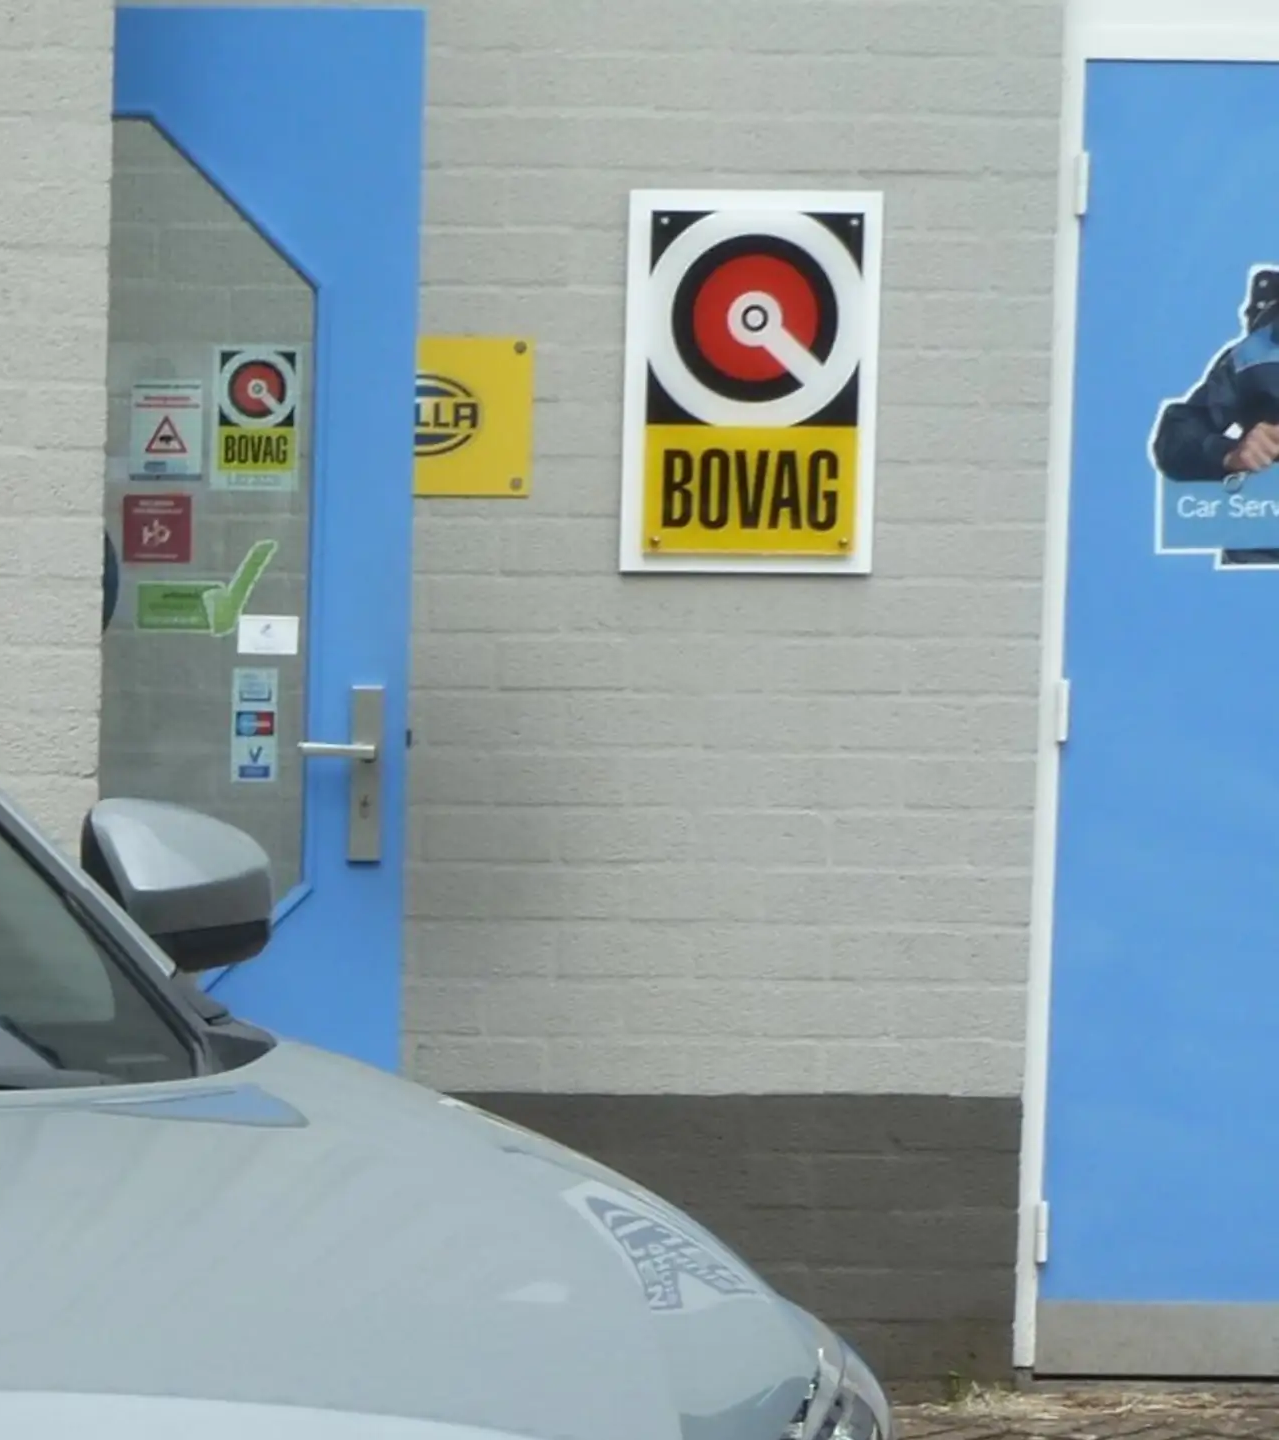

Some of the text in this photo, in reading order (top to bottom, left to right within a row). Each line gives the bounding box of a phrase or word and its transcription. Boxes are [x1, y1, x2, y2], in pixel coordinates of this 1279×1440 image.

[223, 434, 289, 465] BOVAG
[661, 448, 839, 532] BOVAG
[1177, 495, 1222, 518] Car
